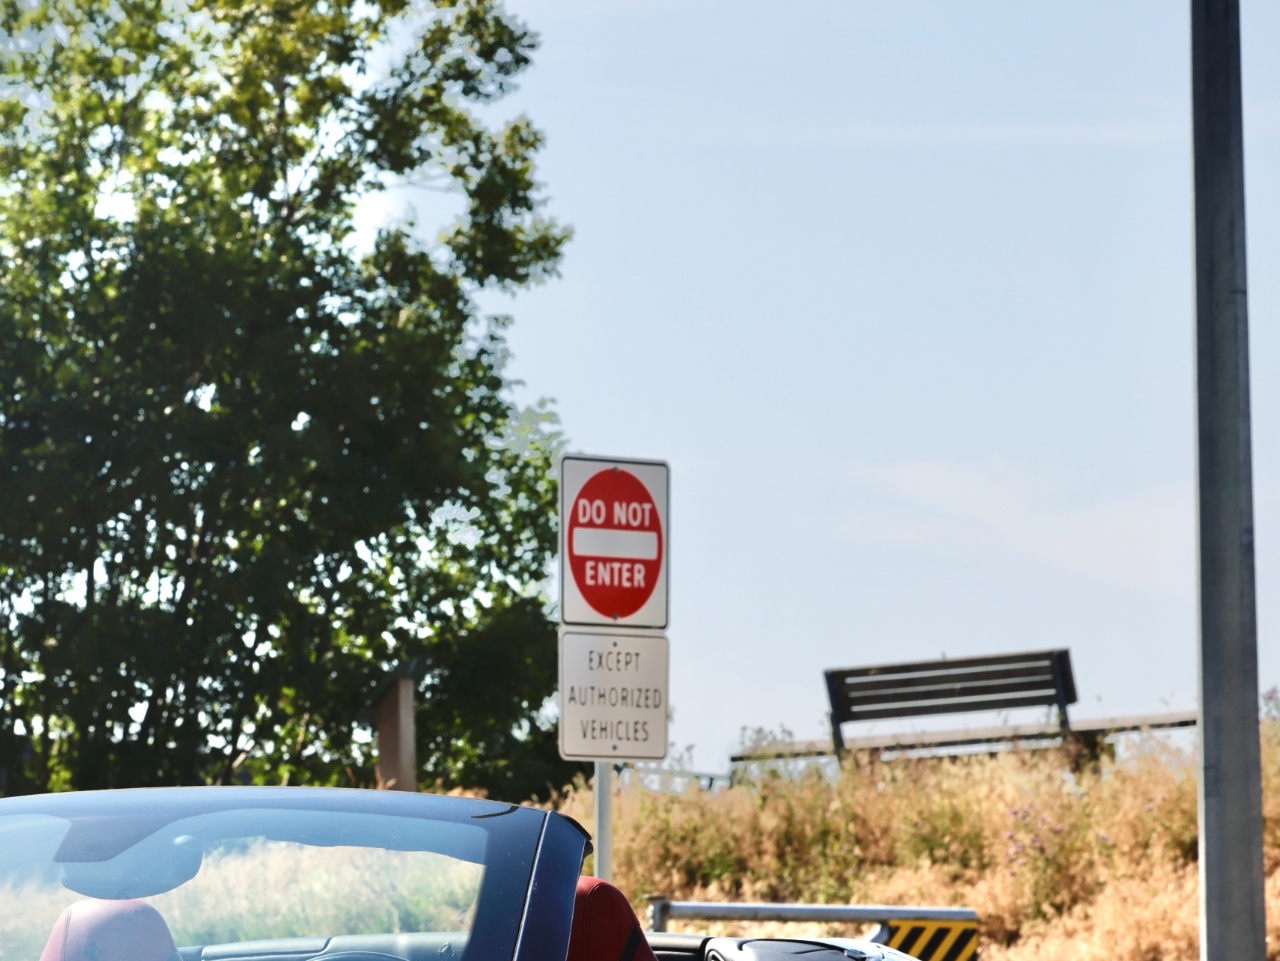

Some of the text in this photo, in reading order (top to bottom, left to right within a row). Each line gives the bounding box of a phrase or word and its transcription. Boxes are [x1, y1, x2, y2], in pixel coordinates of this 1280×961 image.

[577, 498, 652, 527] DO NOT
[585, 560, 646, 588] ENTER
[588, 649, 640, 672] EXCEPT
[568, 685, 662, 709] AUTHORIZED
[580, 719, 649, 742] VEHICLES
